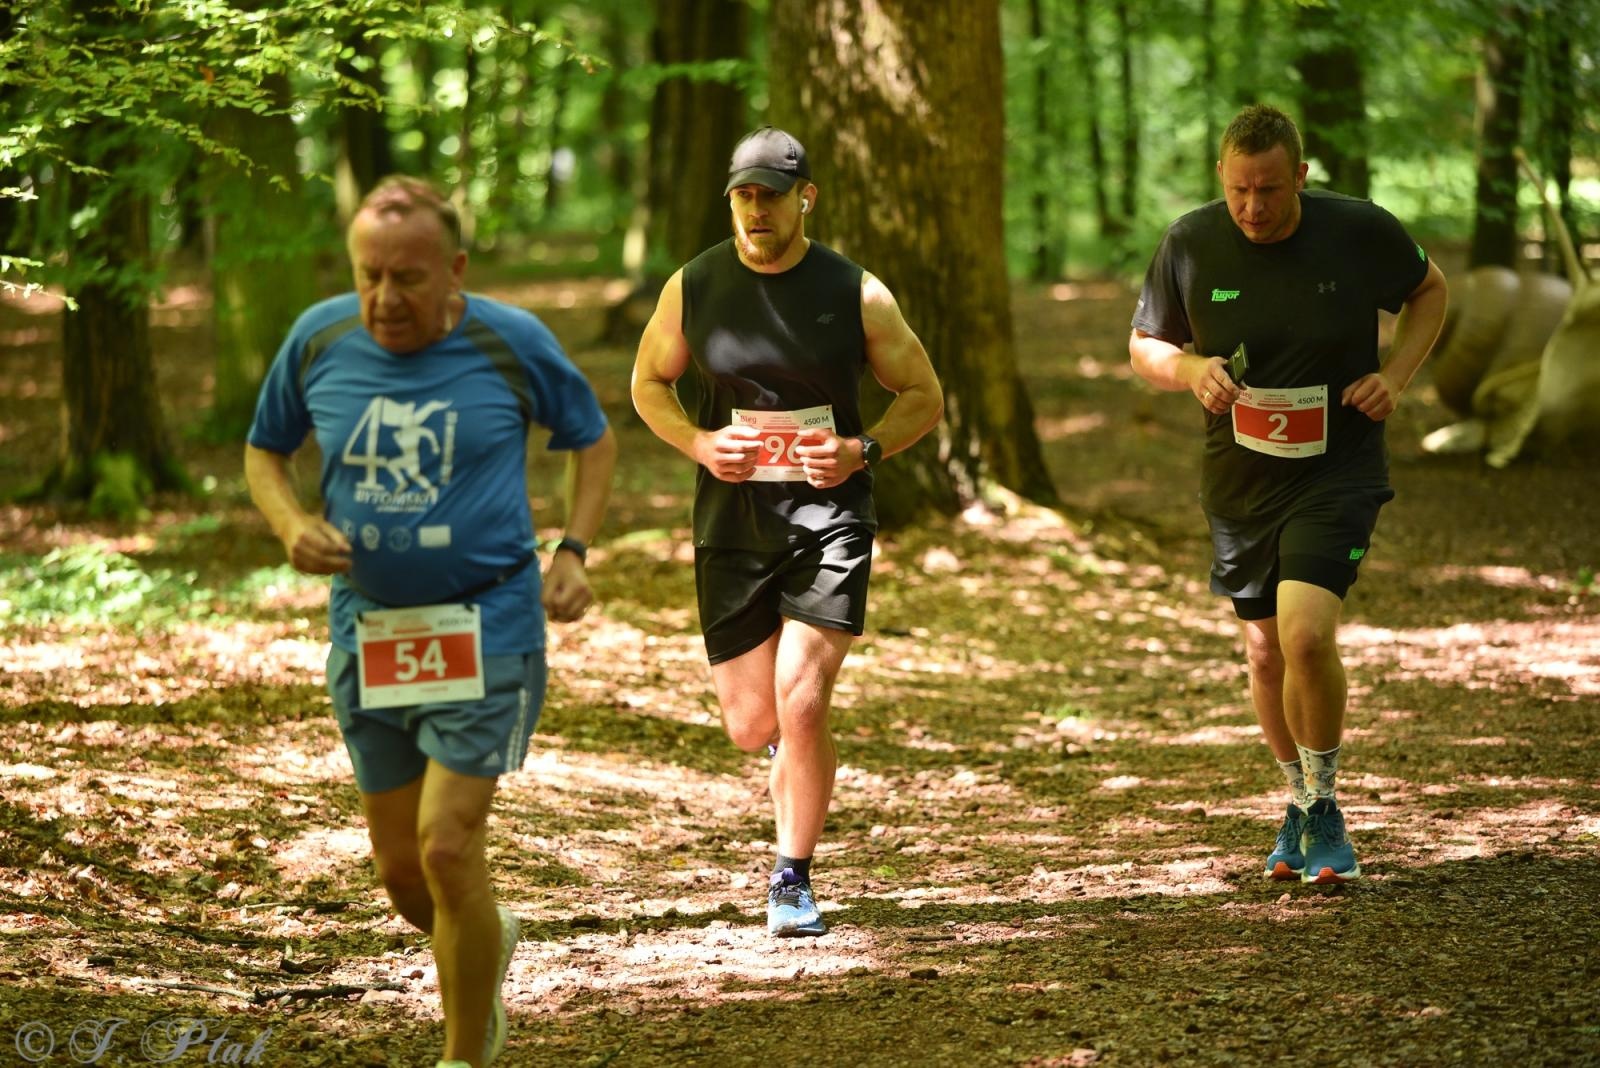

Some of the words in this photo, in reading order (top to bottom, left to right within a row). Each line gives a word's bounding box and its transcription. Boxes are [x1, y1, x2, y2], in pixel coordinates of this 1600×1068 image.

[1211, 289, 1240, 301] fugor
[816, 313, 835, 324] 4F
[804, 417, 820, 426] 4500
[822, 415, 829, 423] M
[1268, 413, 1288, 441] 2
[394, 638, 448, 682] 54
